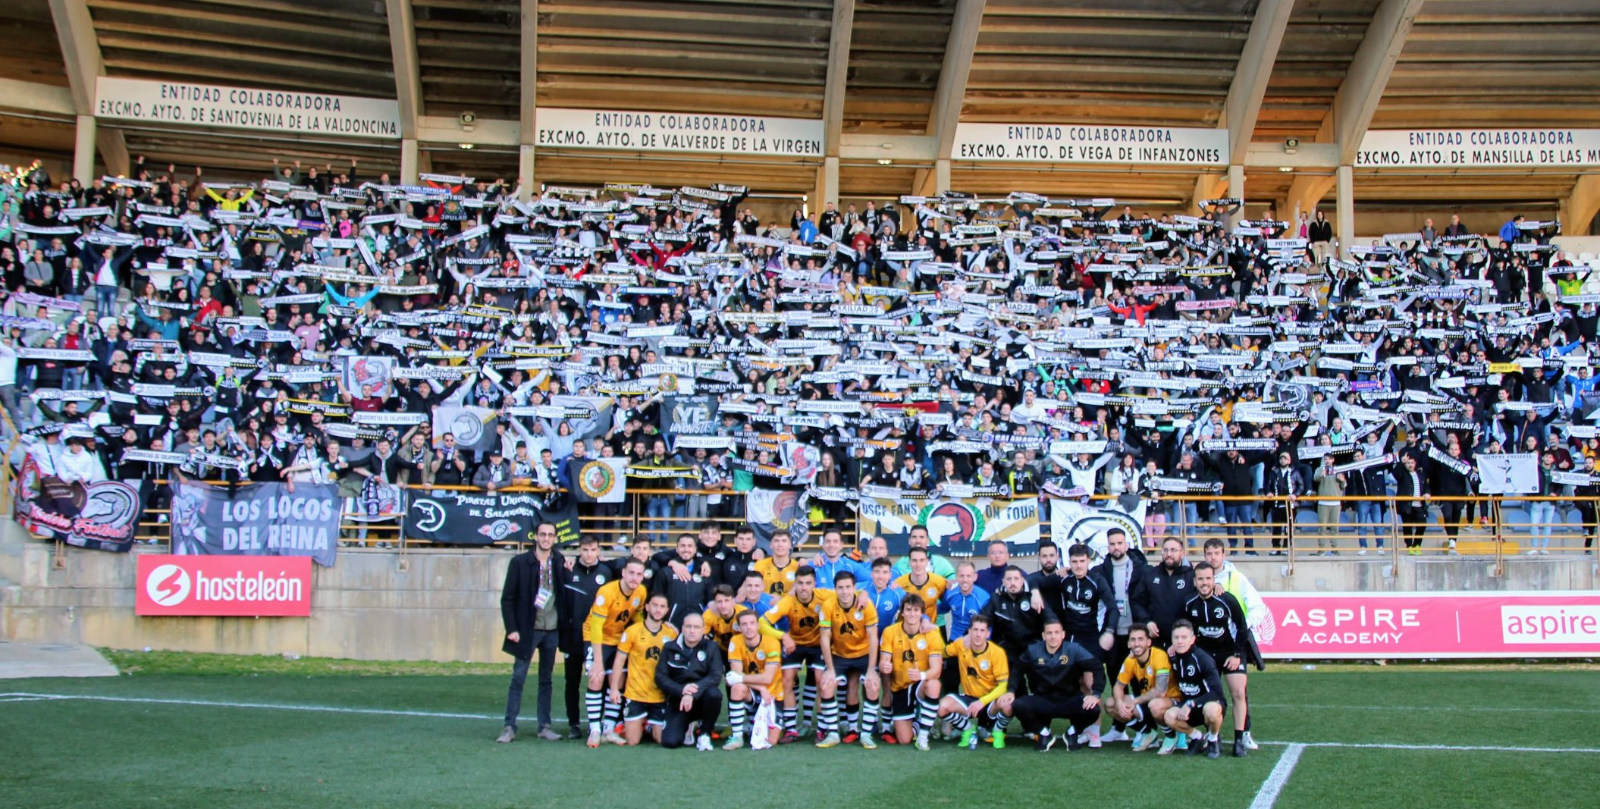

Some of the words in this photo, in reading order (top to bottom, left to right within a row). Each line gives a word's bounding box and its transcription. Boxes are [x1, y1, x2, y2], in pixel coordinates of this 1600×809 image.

[161, 84, 220, 103] ENTIDAD
[230, 89, 341, 113] COLABORADORA
[100, 100, 146, 117] EXCMO.
[152, 105, 185, 121] AYTO.
[191, 107, 205, 122] DE
[210, 109, 284, 128] SANTOVENIA
[288, 114, 302, 129] DE
[307, 115, 320, 130] LA
[324, 117, 397, 135] VALDONCINA
[595, 113, 652, 128] ENTIDAD
[659, 115, 766, 133] COLABORADORA
[539, 130, 590, 145] EXCMO.
[596, 131, 635, 147] AYTO.
[641, 133, 656, 147] DE
[662, 134, 725, 150] VALVERDE
[732, 137, 747, 151] DE
[751, 138, 767, 151] LA
[772, 138, 820, 154] VIRGEN
[1008, 126, 1062, 140] ENTIDAD
[1070, 127, 1172, 143] COLABORADORA
[1409, 132, 1463, 146] ENTIDAD
[1471, 131, 1574, 145] COLABORADORA
[961, 144, 1010, 158] EXCMO.
[1016, 145, 1053, 159] AYTO.
[1059, 146, 1073, 159] DE
[1079, 147, 1113, 160] VEGA
[1119, 147, 1133, 160] DE
[1139, 148, 1220, 162] INFANZONES
[1357, 151, 1404, 164] EXCMO.
[1409, 151, 1446, 164] AYTO.
[1451, 150, 1465, 163] DE
[1472, 150, 1534, 164] MANSILLA
[1541, 150, 1554, 163] DE
[1560, 149, 1581, 163] LAS
[1587, 149, 1600, 162] M
[457, 257, 494, 265] UNIONISTAS
[716, 345, 761, 353] UNIONISTAS
[641, 363, 695, 379] DISIDENCIA
[795, 416, 819, 425] FANS
[1428, 421, 1474, 430] UNIONISTAS
[222, 500, 260, 522] LOS
[268, 497, 333, 521] LOCOS
[891, 503, 917, 516] FANS
[985, 505, 1000, 520] ON
[1006, 504, 1036, 521] TOUR
[222, 526, 261, 550] DEL
[268, 525, 329, 550] REINA
[196, 570, 302, 602] hosteleón
[1281, 606, 1420, 631] ASPIRE
[1507, 610, 1597, 640] aspire
[1299, 632, 1404, 644] ACADEMY
